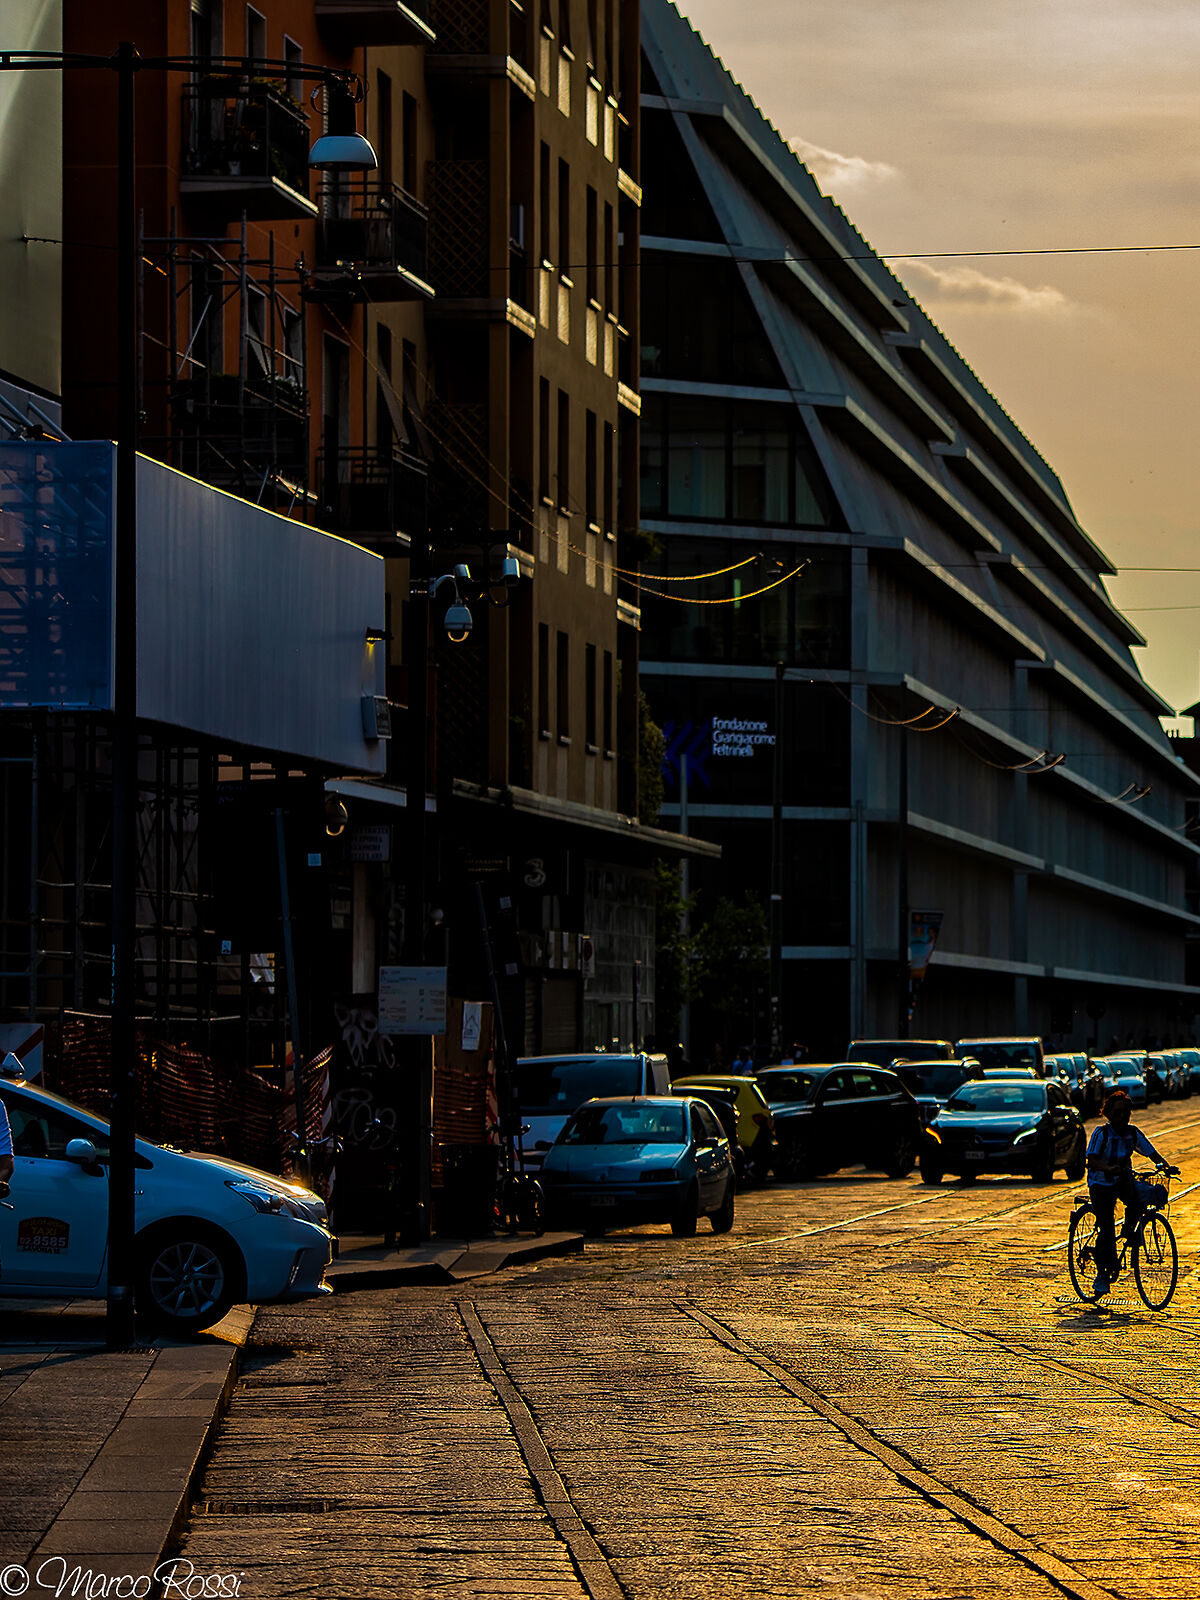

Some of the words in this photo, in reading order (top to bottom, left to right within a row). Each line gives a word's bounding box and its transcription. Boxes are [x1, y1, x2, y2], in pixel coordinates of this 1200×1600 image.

[712, 716, 768, 732] Fondazione
[712, 743, 754, 757] Feltrinelli
[32, 1226, 57, 1236] TAXI
[33, 1234, 67, 1248] 8585
